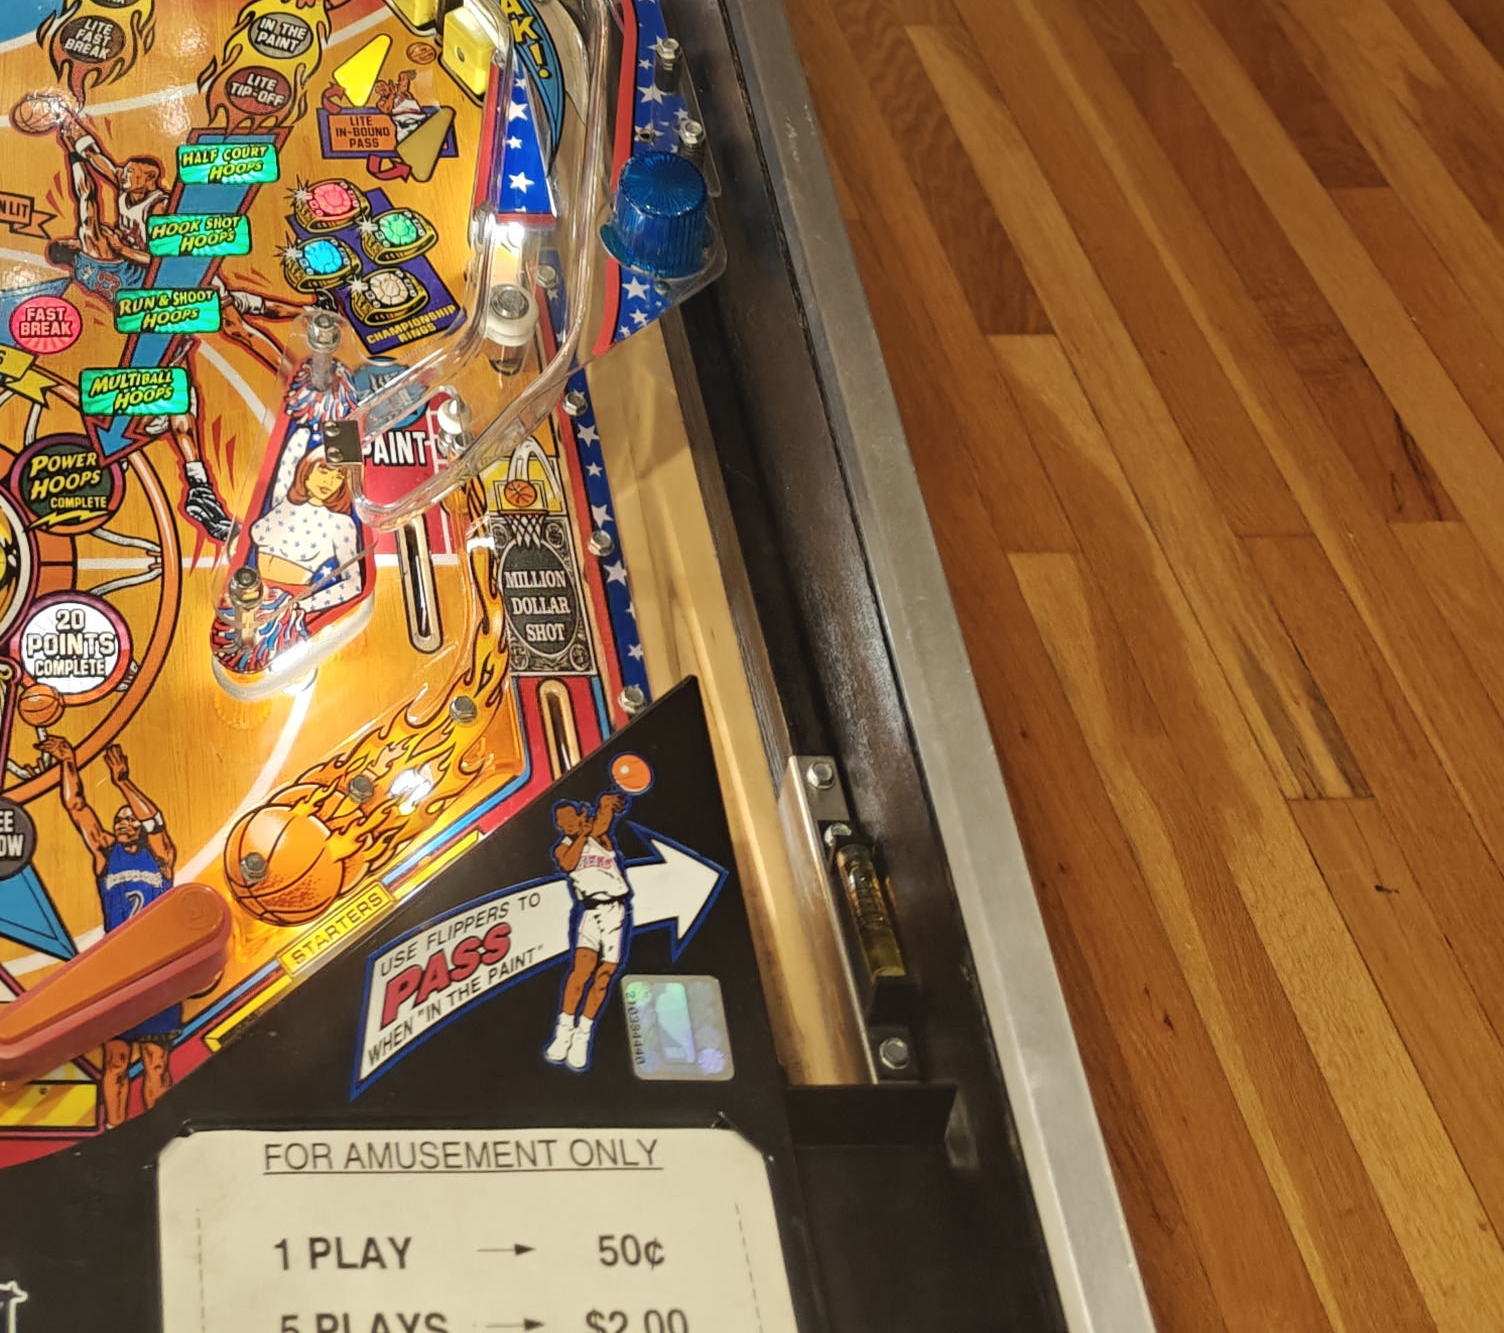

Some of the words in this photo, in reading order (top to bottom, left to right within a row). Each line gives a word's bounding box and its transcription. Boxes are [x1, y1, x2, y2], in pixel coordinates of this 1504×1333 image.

[76, 28, 112, 46] FAST
[84, 18, 114, 34] LITE
[260, 17, 278, 33] IN
[280, 22, 308, 40] THE
[65, 40, 111, 59] BREAK
[256, 30, 301, 52] PAINT
[246, 73, 277, 90] LITE
[230, 82, 285, 107] TIP-OFF
[349, 115, 373, 127] LITE
[335, 126, 391, 139] IN-BOUND
[348, 137, 380, 149] PASS
[180, 149, 218, 167] HALF
[222, 144, 268, 161] COURT
[208, 159, 263, 180] HOOPS
[8, 200, 31, 219] LIT
[151, 221, 199, 240] HOOK
[204, 215, 240, 232] SHOT
[180, 230, 237, 252] HOOPS
[26, 306, 66, 322] FAST
[118, 296, 156, 317] RUN
[158, 294, 170, 306] &
[172, 289, 215, 306] SHOOT
[143, 307, 200, 329] HOOPS
[366, 303, 458, 347] CHAMPIONSHIP
[20, 321, 73, 338] BREAK
[398, 322, 438, 344] RINGS
[90, 371, 174, 397] MULTIBALL
[114, 386, 174, 411] HOOPS
[30, 451, 98, 479] POWER
[31, 469, 101, 502] HOOPS
[50, 494, 109, 510] COMPLETE
[503, 569, 567, 589] MILLION
[511, 595, 571, 616] DOLLAR
[56, 608, 86, 632] 20
[525, 622, 566, 642] SHOT
[27, 633, 116, 660] POINTS
[32, 655, 107, 679] COMPLETE
[289, 886, 388, 968] STARTERS
[378, 946, 420, 977] USE
[424, 899, 512, 958] FLIPPERS
[517, 890, 543, 913] TO
[378, 921, 513, 1028] PASS
[265, 1141, 335, 1172] FOR
[343, 1139, 559, 1172] AMUSEMENT
[568, 1137, 660, 1169] ONLY
[273, 1238, 291, 1271] 1
[309, 1236, 413, 1271] PLAY
[597, 1234, 666, 1271] 50¢
